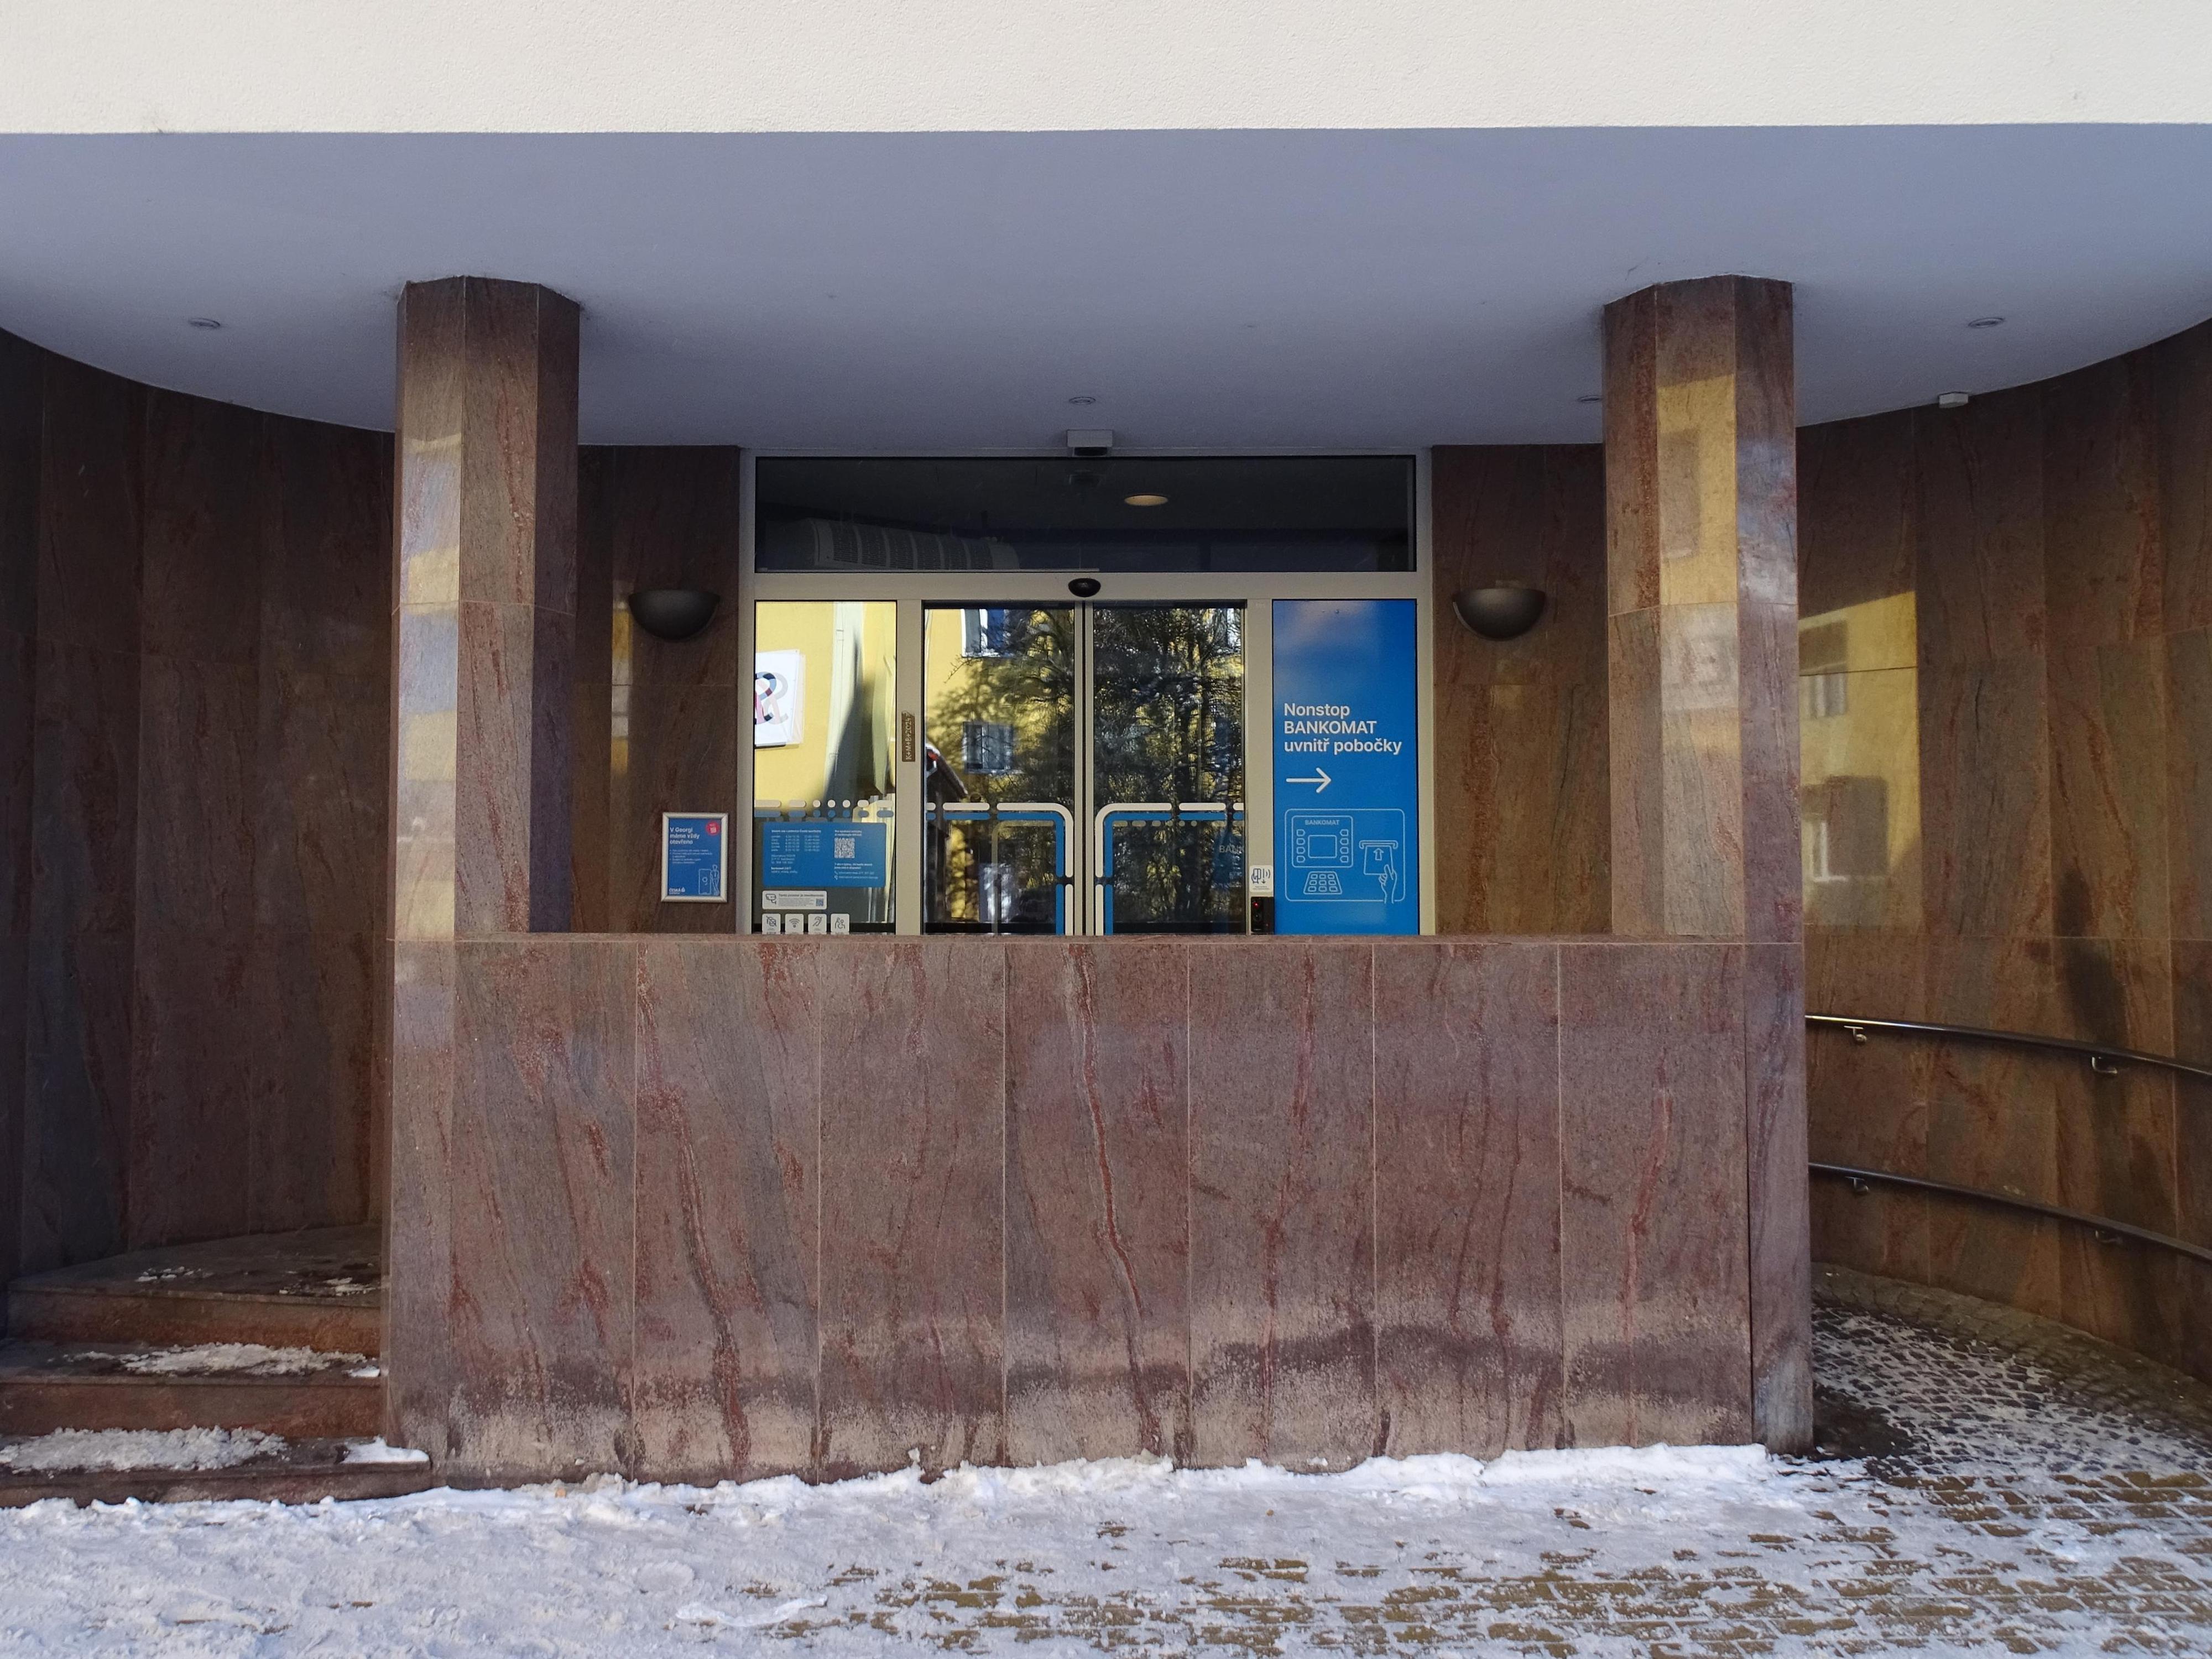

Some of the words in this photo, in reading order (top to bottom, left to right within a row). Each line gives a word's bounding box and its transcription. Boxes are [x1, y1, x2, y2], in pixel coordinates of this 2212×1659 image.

[1284, 703, 1350, 719] Nonstop
[1284, 721, 1377, 734] BANKOMAT
[1284, 738, 1329, 752] uvnitř
[1334, 738, 1402, 755] pobočky
